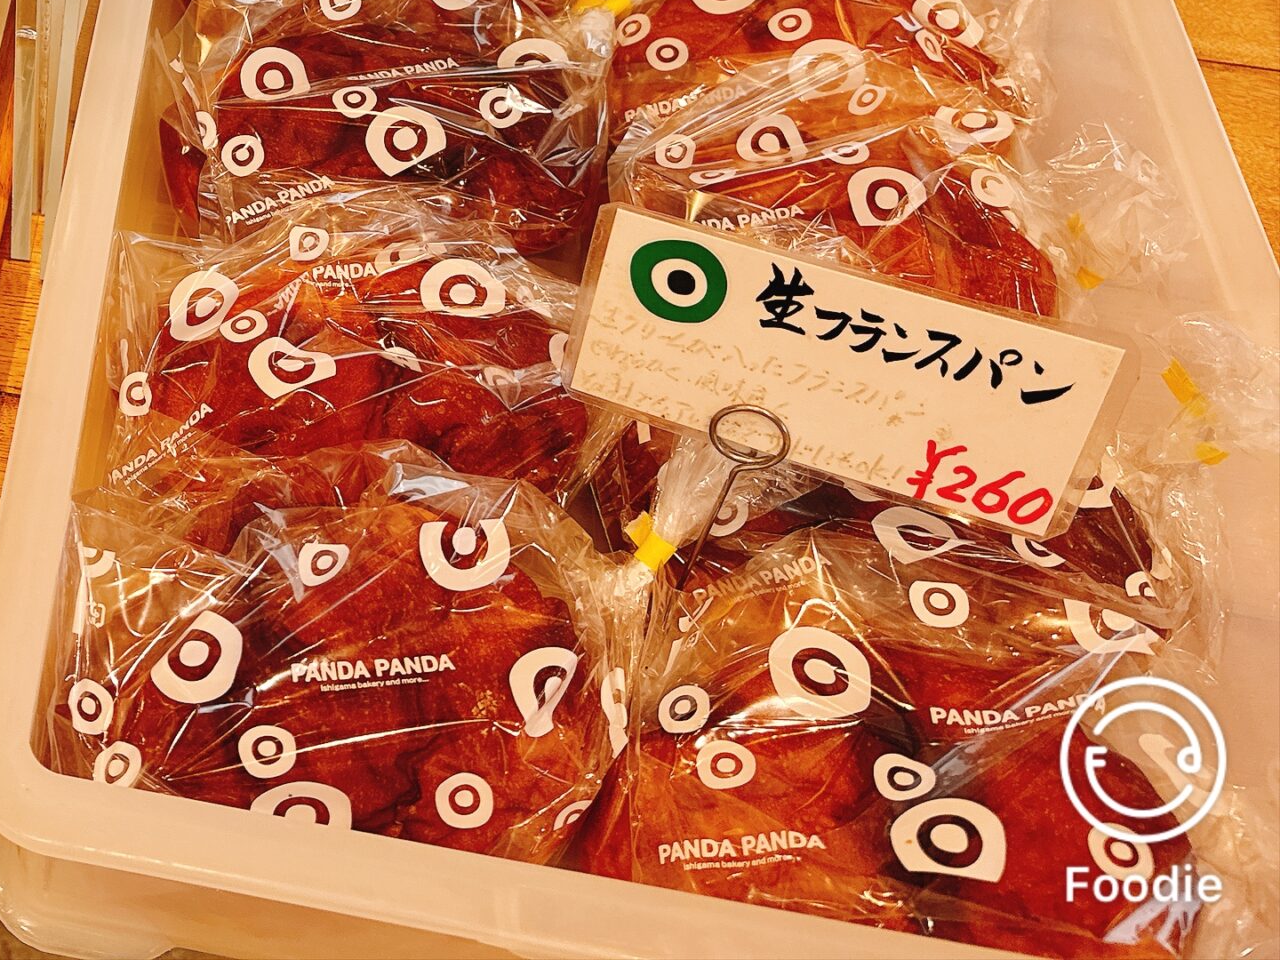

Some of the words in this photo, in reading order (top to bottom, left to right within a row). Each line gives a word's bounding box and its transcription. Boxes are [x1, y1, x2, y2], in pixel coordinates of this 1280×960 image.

[402, 57, 460, 76] PANDA
[277, 175, 336, 204] PANDA
[736, 204, 805, 229] PANDA
[312, 261, 378, 280] PANDA
[754, 261, 1077, 406] 生フランスパン
[906, 438, 1054, 526] ¥260
[758, 552, 833, 585] PANDA
[290, 659, 371, 683] PANDA
[373, 653, 456, 678] PANDA
[385, 677, 401, 686] and
[928, 706, 1020, 726] PANDA
[657, 838, 737, 865] PANDA
[740, 830, 827, 856] PANDA
